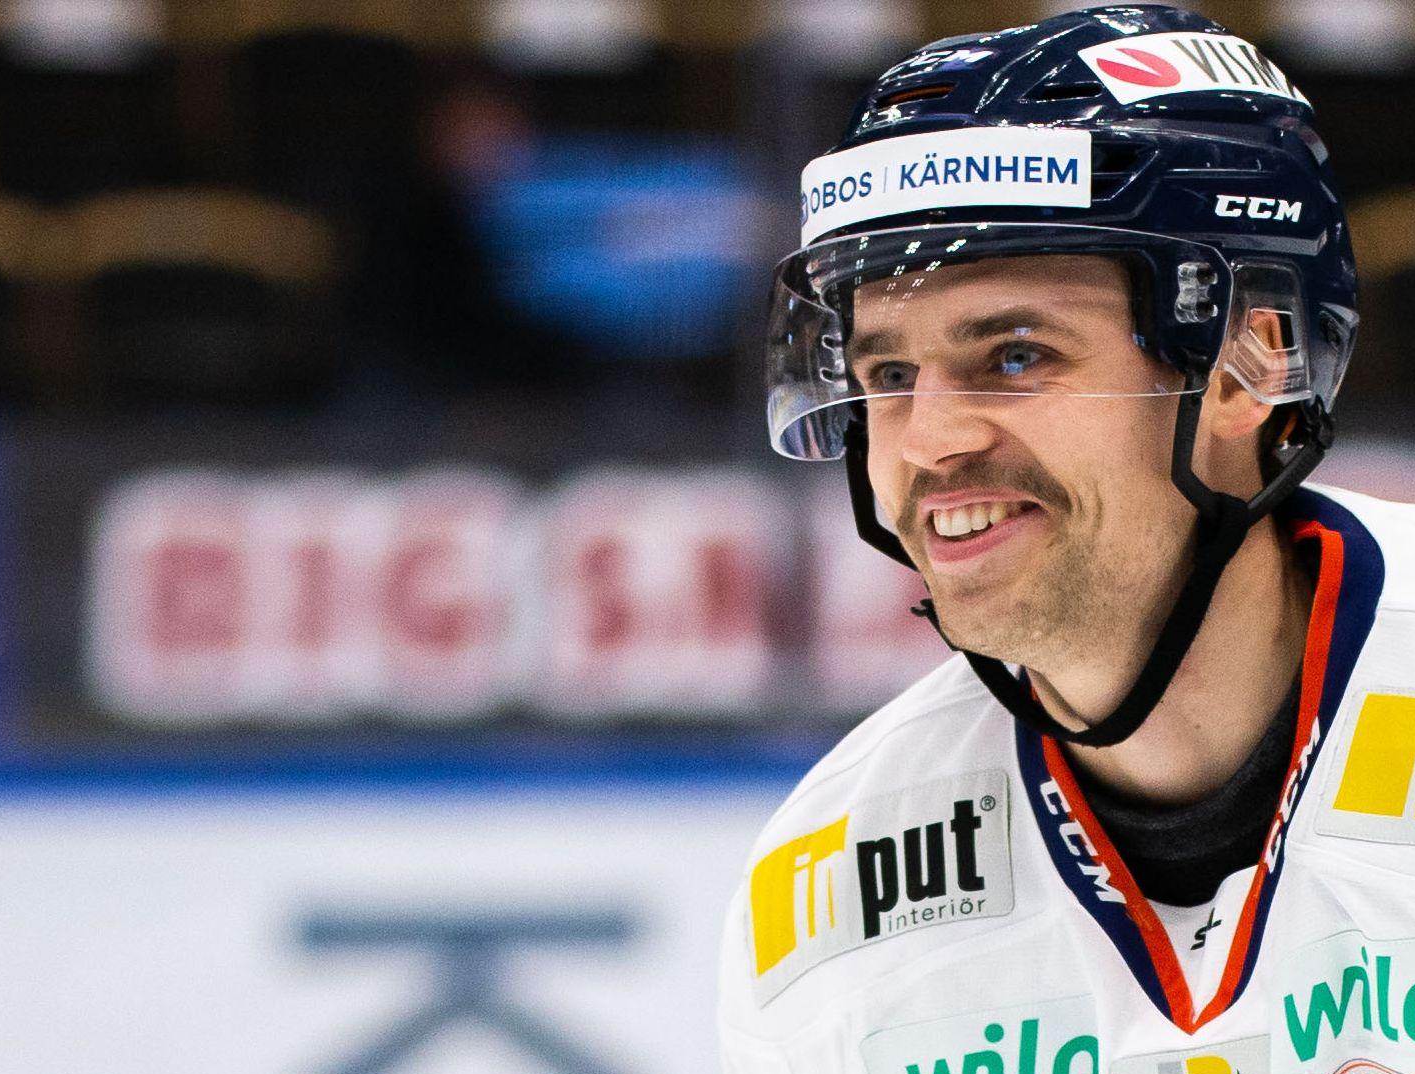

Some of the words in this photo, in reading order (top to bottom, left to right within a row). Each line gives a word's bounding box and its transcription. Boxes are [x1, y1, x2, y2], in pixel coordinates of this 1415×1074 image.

[809, 171, 873, 214] OBOS
[899, 152, 1078, 190] KÄRNHEM
[1215, 195, 1303, 223] CCM
[1039, 777, 1128, 905] CCM
[887, 895, 986, 934] interiör
